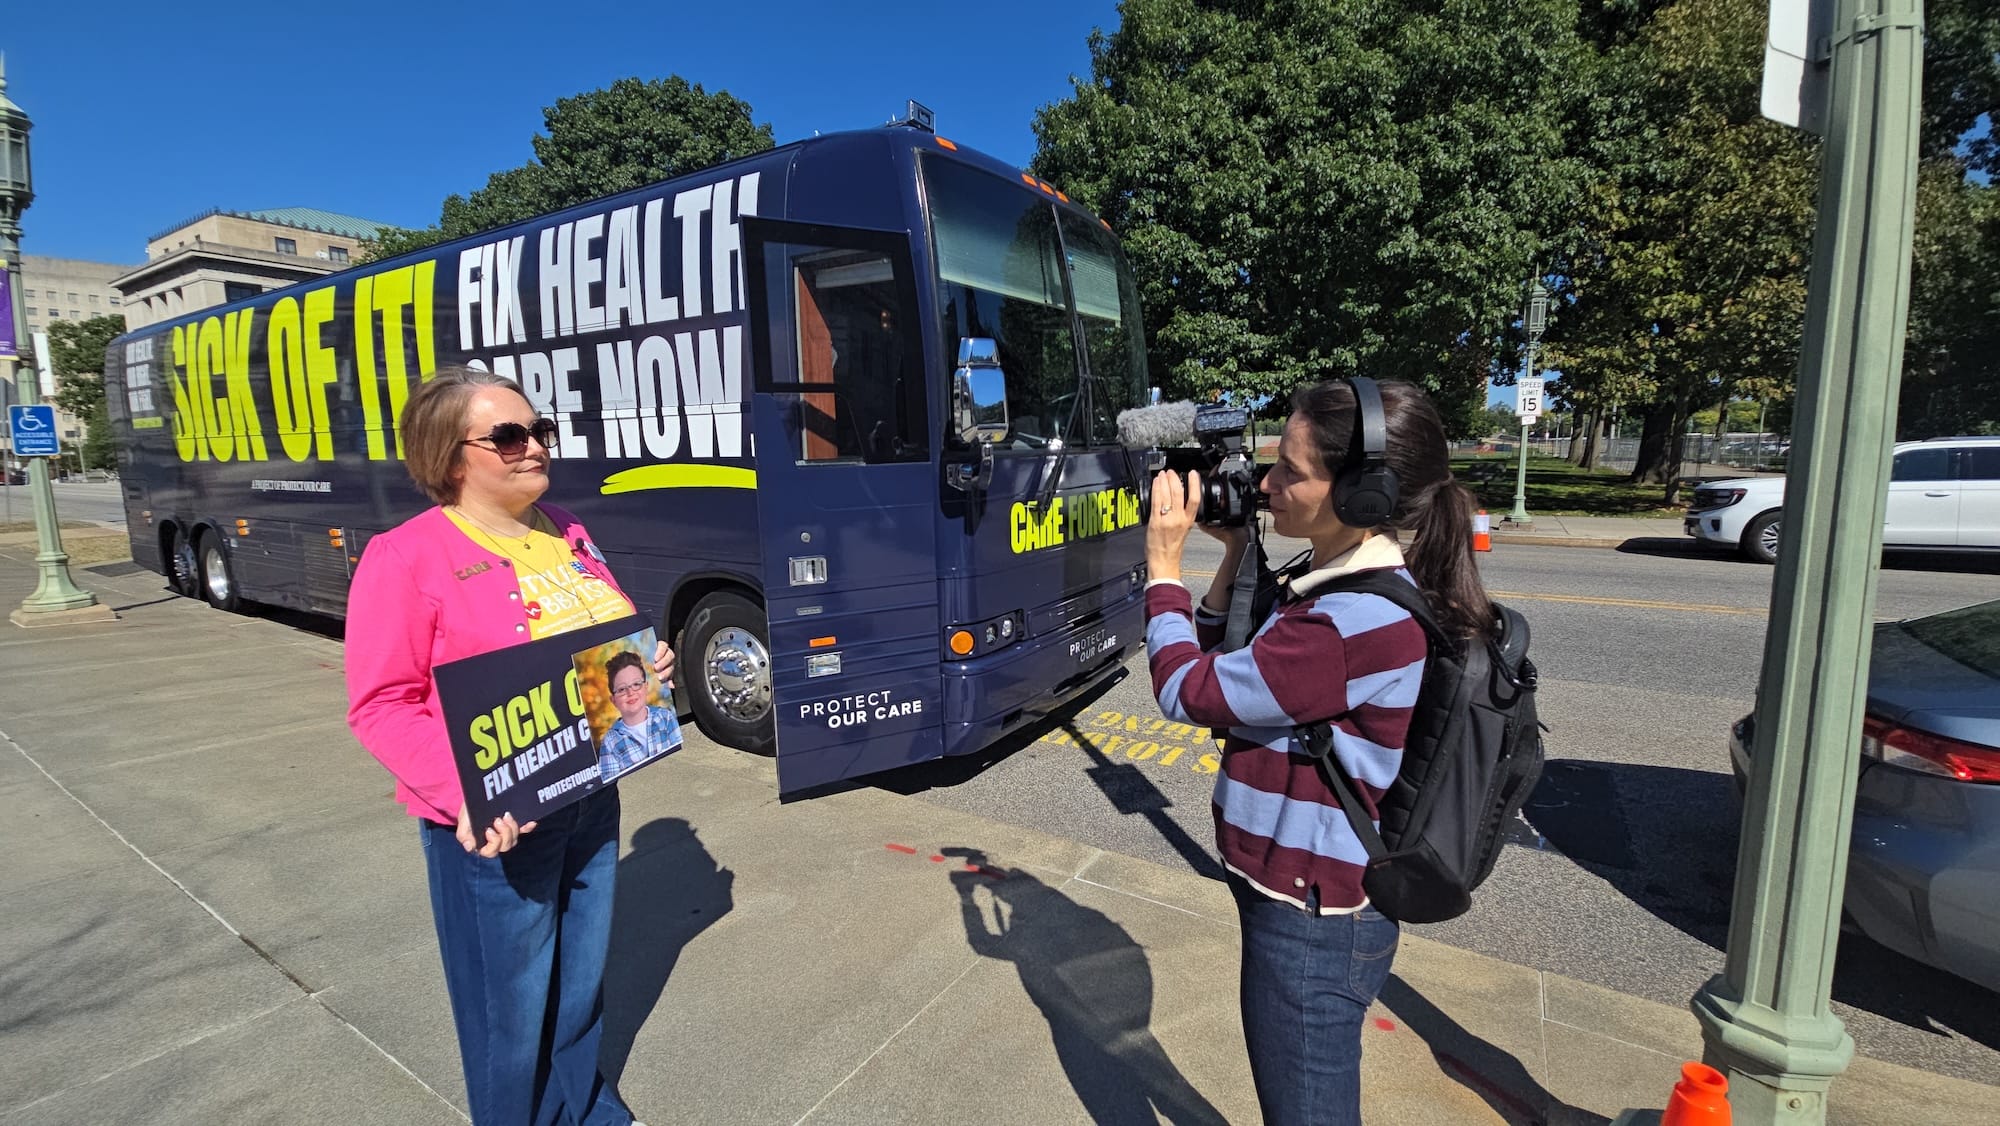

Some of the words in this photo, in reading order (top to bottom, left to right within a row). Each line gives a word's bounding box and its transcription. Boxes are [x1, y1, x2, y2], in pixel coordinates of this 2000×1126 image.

[458, 235, 527, 350] FIX
[539, 172, 760, 339] HEALTH
[165, 307, 268, 462] SICK
[268, 286, 338, 462] OF
[467, 347, 589, 458] RE
[596, 325, 755, 459] NOW
[1522, 398, 1537, 412] 15
[315, 481, 332, 492] CARE
[1010, 497, 1065, 554] CARE
[1068, 489, 1116, 541] FORCE
[1117, 487, 1140, 529] ONE
[455, 560, 492, 581] CARE
[1070, 629, 1105, 656] PROTECT
[1080, 647, 1096, 662] OUR
[1098, 635, 1117, 653] CARE
[800, 690, 891, 718] PROTECT
[828, 710, 867, 728] OUR
[875, 700, 922, 720] CARE
[469, 681, 561, 770] SICK
[564, 668, 586, 716] O
[483, 763, 515, 801] FIX
[514, 726, 577, 781] HEALTH
